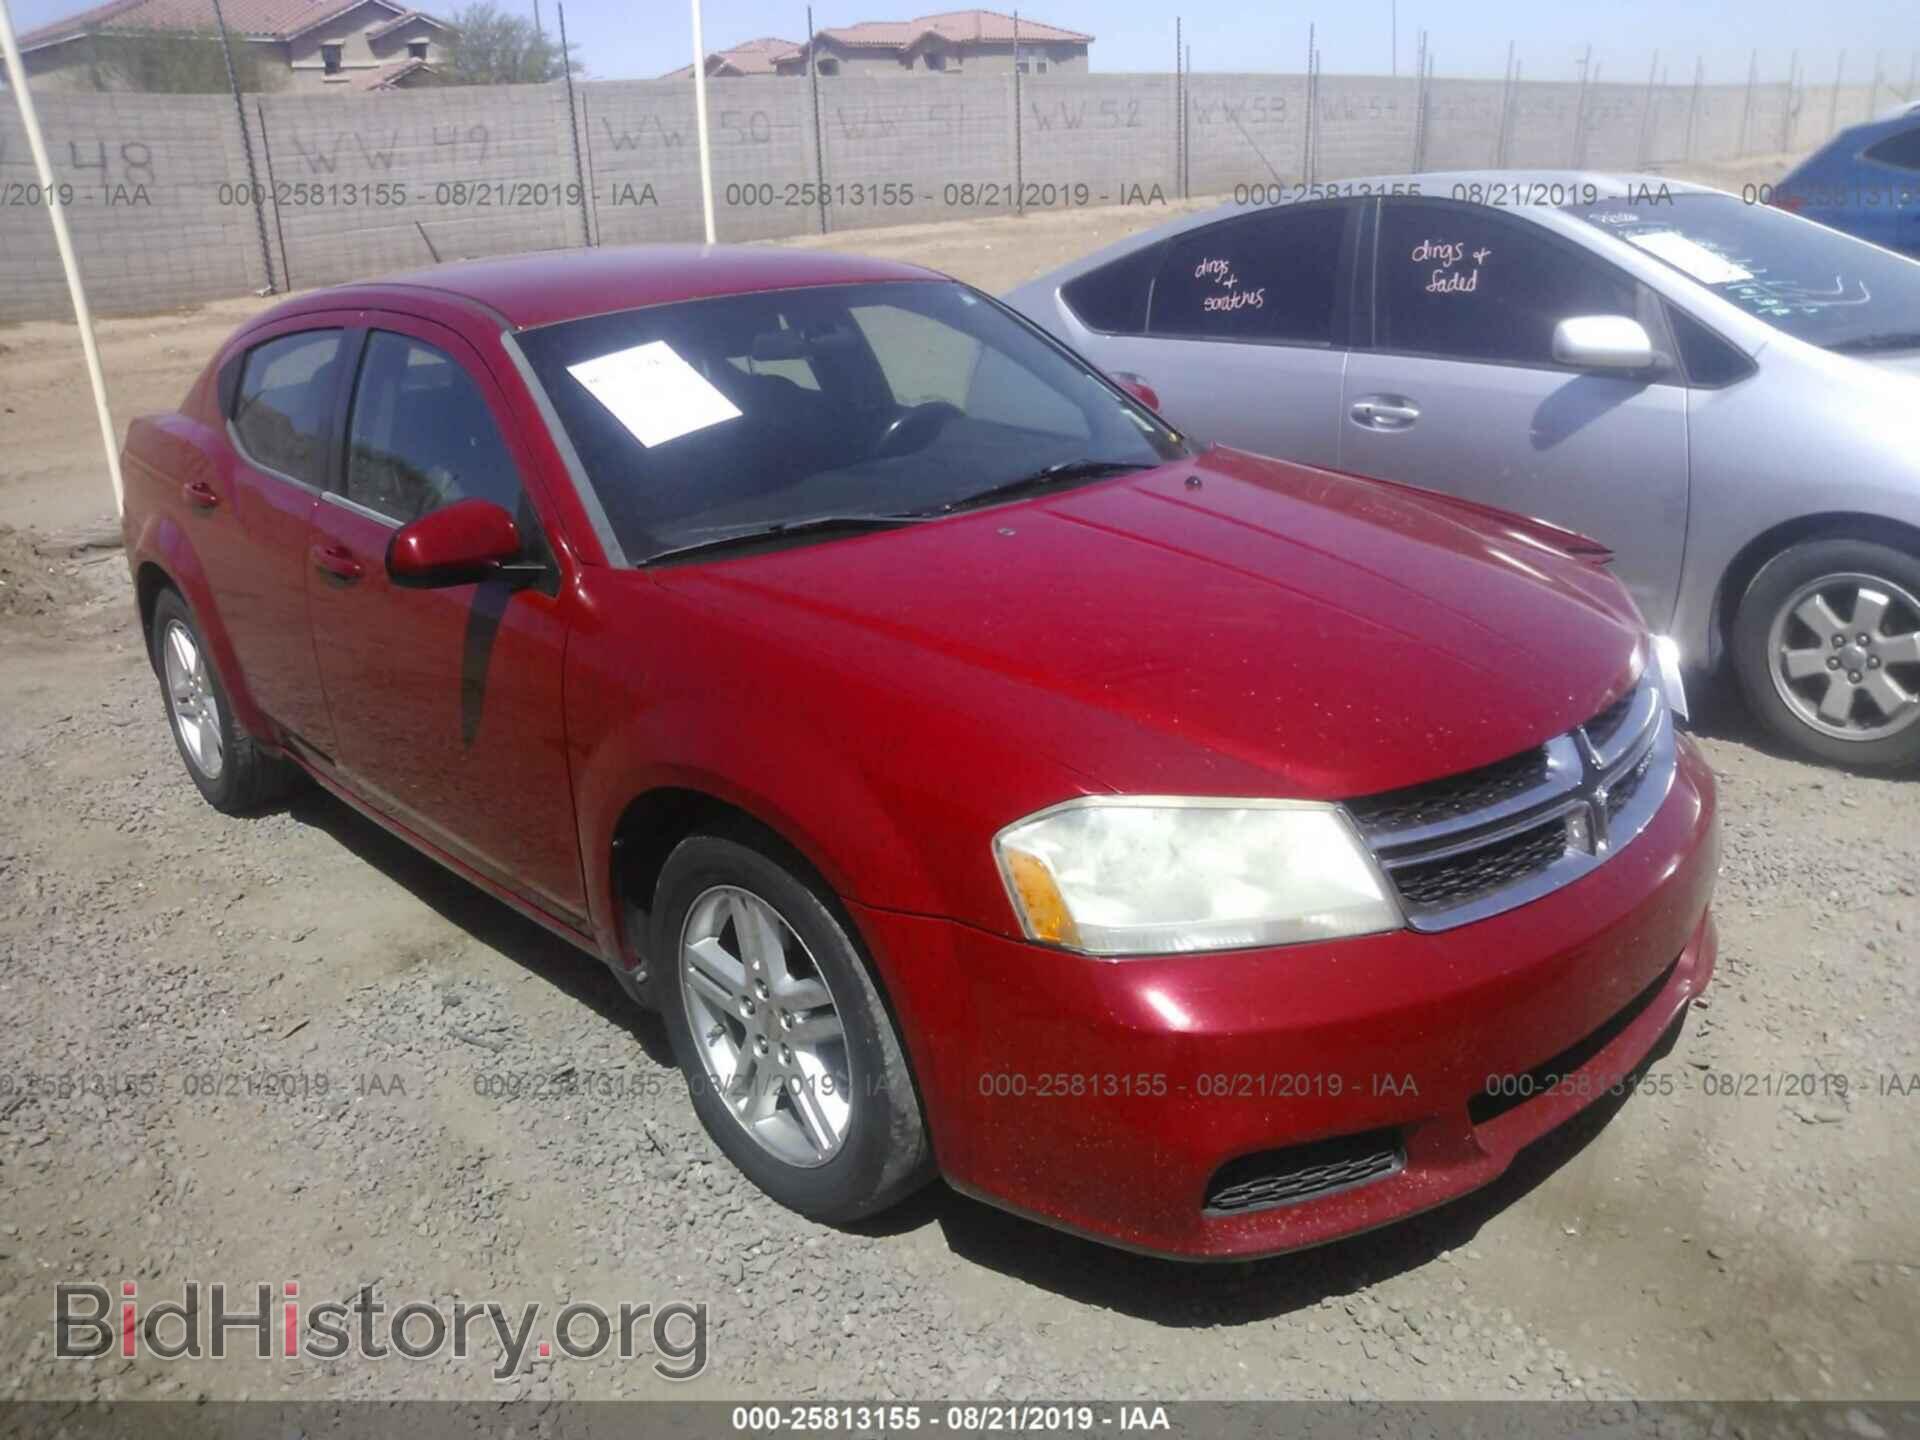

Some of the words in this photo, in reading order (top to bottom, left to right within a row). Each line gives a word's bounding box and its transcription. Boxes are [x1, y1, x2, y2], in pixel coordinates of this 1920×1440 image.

[1099, 98, 1142, 129] 52
[1253, 96, 1287, 124] 53
[720, 109, 770, 146] 50
[432, 124, 489, 165] 49
[69, 139, 156, 188] 48
[1412, 239, 1464, 268] dings
[1194, 257, 1230, 283] dings
[1425, 269, 1478, 293] faded
